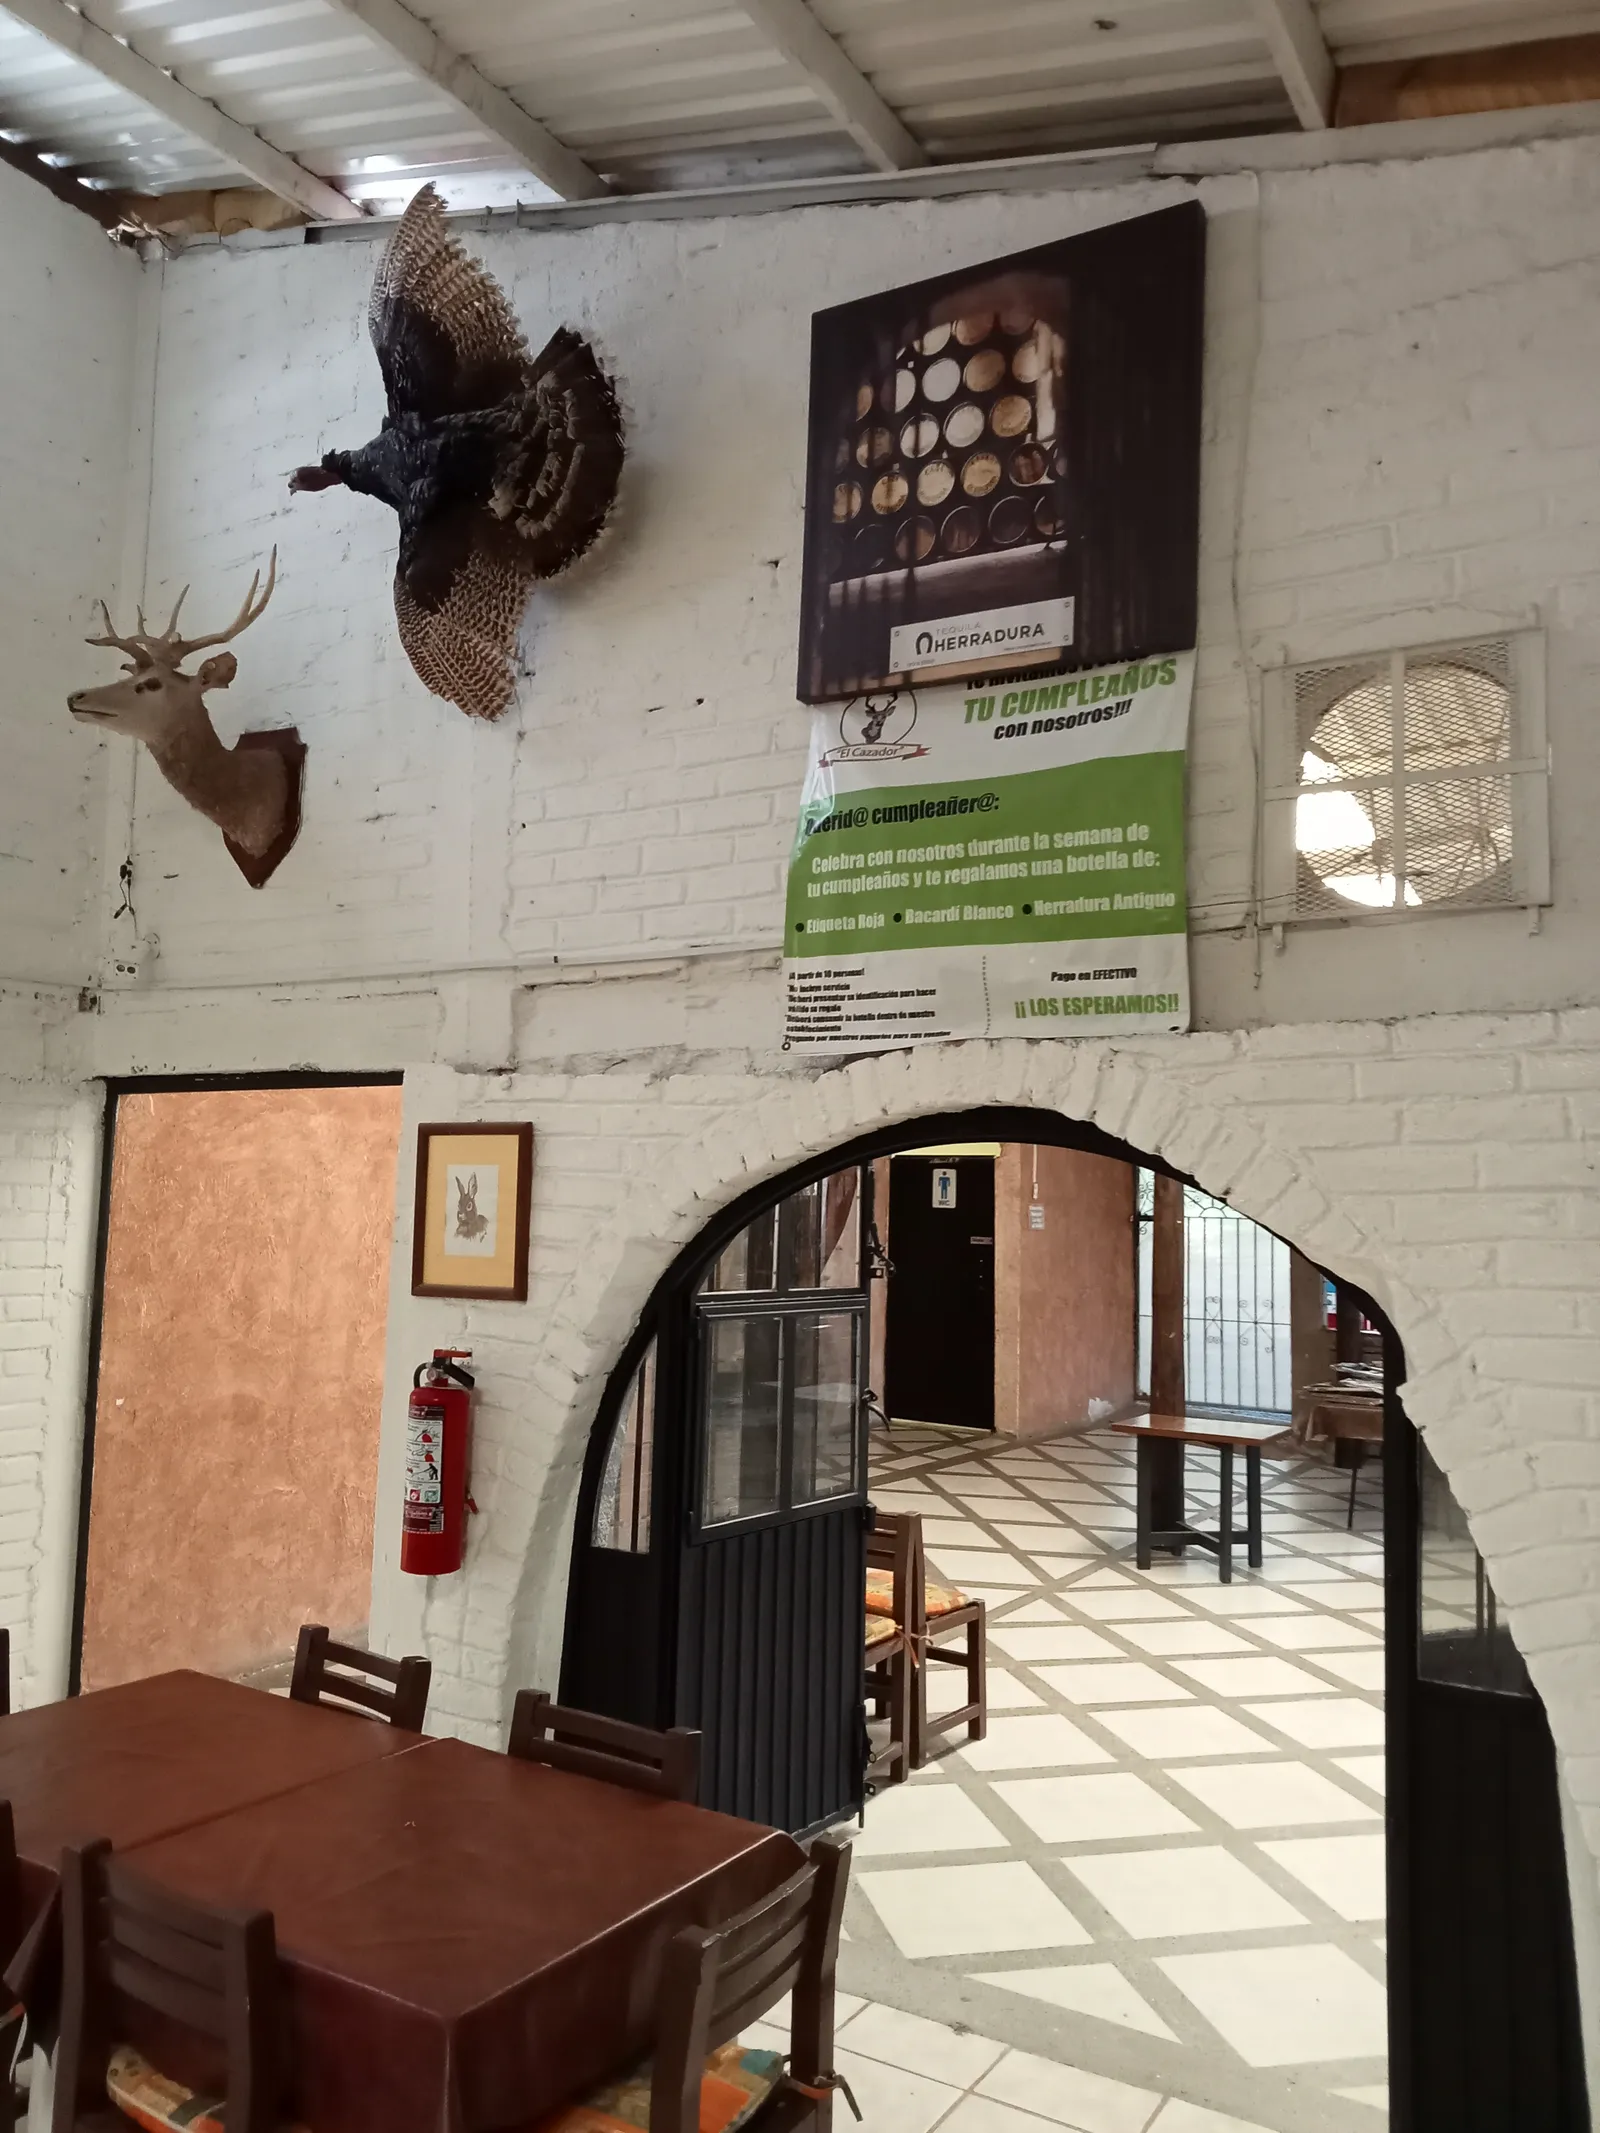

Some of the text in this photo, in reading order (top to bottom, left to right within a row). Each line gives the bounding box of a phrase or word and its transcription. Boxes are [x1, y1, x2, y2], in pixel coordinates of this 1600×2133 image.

[934, 623, 1045, 652] HERRADURA
[936, 621, 982, 636] TEQUILA
[964, 658, 1177, 724] TU CUMPLEAÑOS
[993, 698, 1133, 740] con nosotros!!!
[872, 792, 1000, 825] cumpleañer@:
[812, 822, 1150, 875] Celebra con nosotros durante la semana de
[807, 849, 1160, 898] tu cumpleaños y te regalamos una botella de:
[904, 904, 1014, 925] Bacardí Blanco
[1034, 891, 1176, 917] Herradura Antiguo
[806, 912, 885, 934] Etiqueta Roja
[1051, 967, 1138, 982] Pago en EFECTIVO
[1029, 997, 1059, 1017] LOS
[1062, 993, 1179, 1017] ESPERAMOS!!
